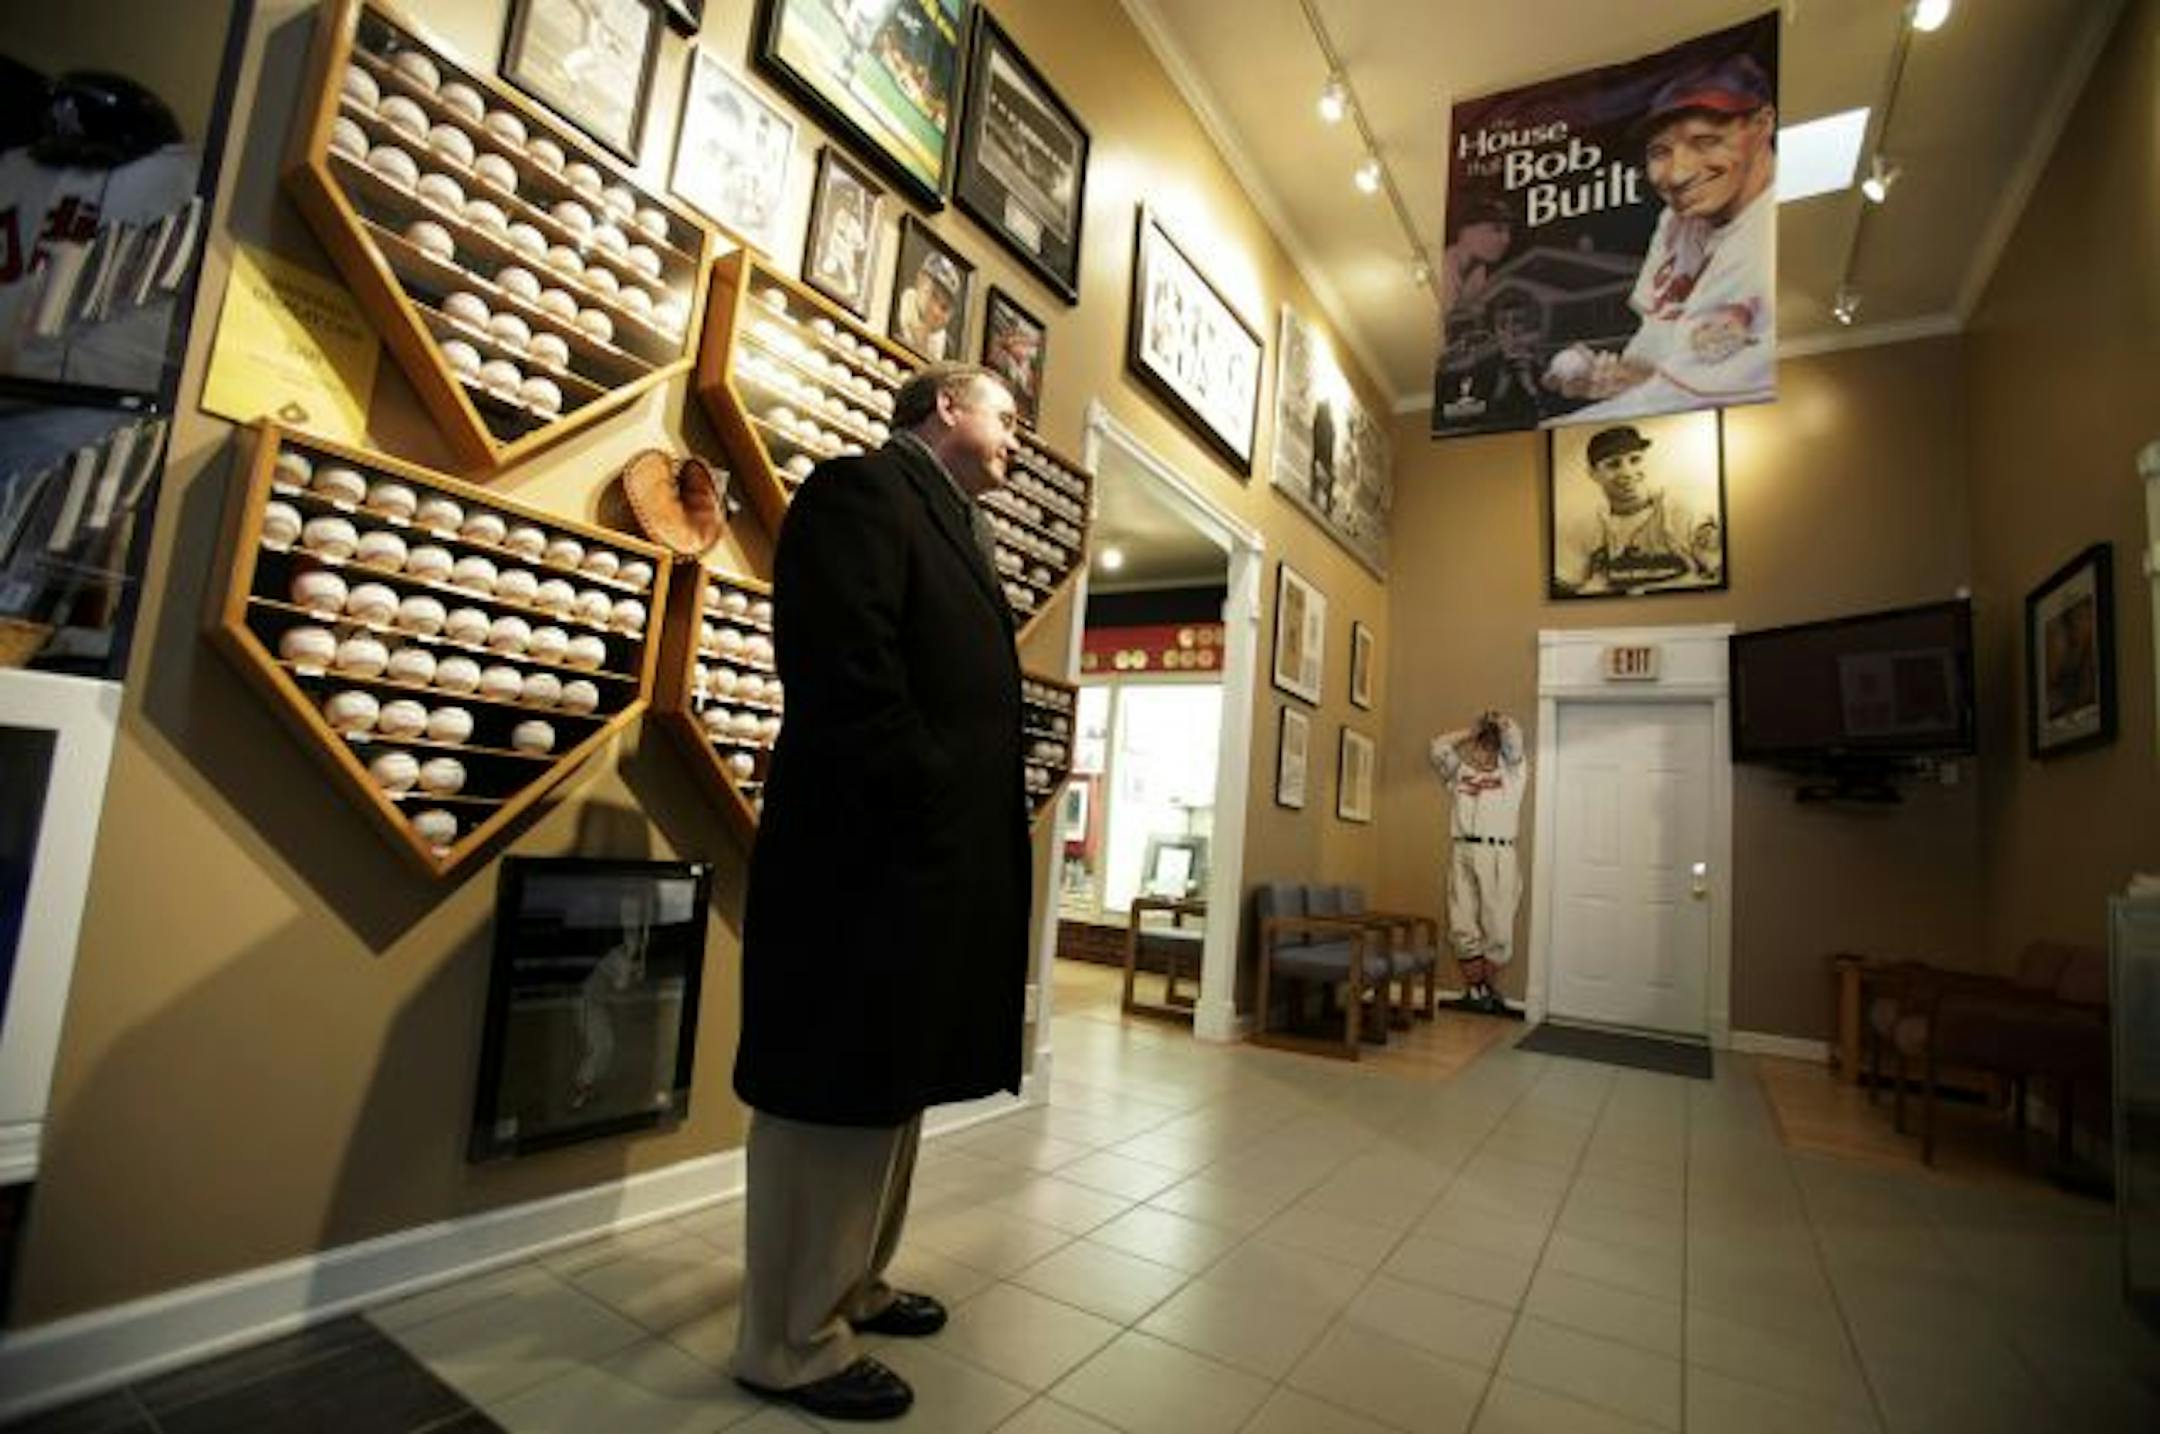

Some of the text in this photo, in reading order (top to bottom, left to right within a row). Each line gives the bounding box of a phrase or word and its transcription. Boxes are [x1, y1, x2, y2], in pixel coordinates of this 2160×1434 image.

[1458, 121, 1568, 159] House
[1504, 138, 1601, 190] Bob
[1527, 160, 1641, 228] Built
[1613, 648, 1651, 674] EXIT
